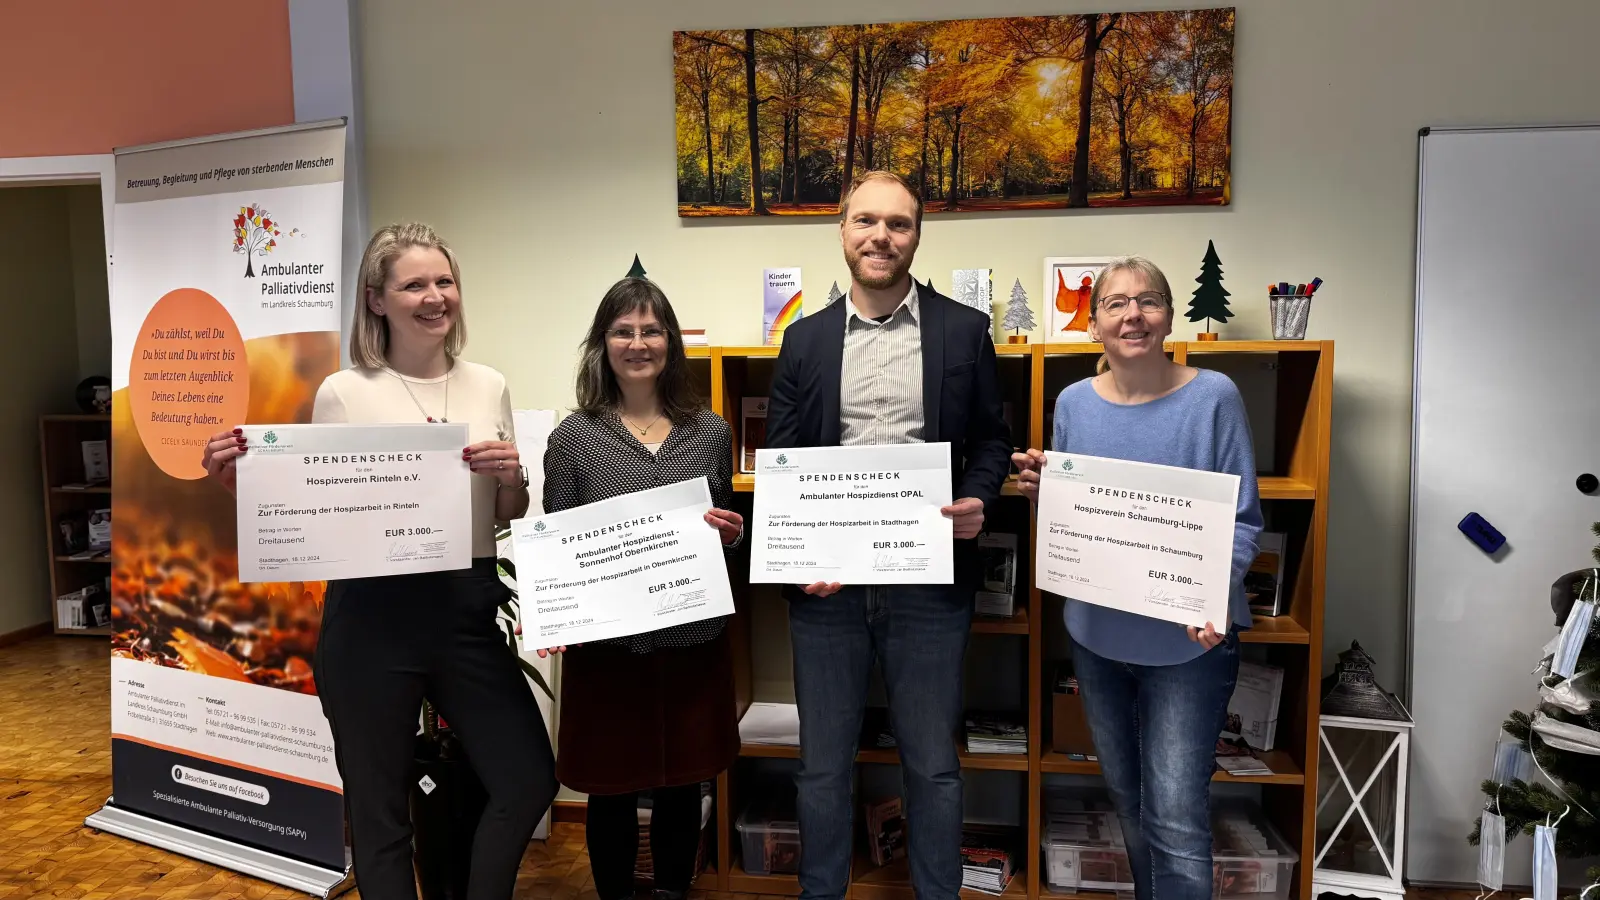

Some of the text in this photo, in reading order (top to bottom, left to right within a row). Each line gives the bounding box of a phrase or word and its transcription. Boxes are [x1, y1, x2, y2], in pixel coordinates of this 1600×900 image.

[127, 157, 334, 189] Betreuung, Begleitung und Pflege von sterbenden Menschen
[261, 262, 324, 276] Ambulanter
[261, 281, 334, 296] Palliativdienst
[261, 299, 334, 309] im Landkreis Schaumburg
[151, 328, 224, 340] »Du zählst, weil Du
[143, 349, 235, 361] Du bist und Du wirst bis
[144, 370, 234, 384] zum letzten Augenblick
[152, 391, 224, 403] Deines Lebens eine
[151, 412, 224, 426] Bedeutung haben.«
[161, 437, 180, 446] CICELY
[304, 454, 422, 464] SPENDENSCHECK
[306, 476, 367, 486] Hospizverein
[370, 475, 402, 483] Rinteln
[800, 472, 900, 482] SPENDENSCHECK
[847, 491, 898, 500] Hospizdienst
[1089, 486, 1193, 508] SPENDENSCHECK
[334, 504, 382, 513] Hospizarbeit
[881, 519, 919, 527] Stadthagen
[1074, 504, 1203, 531] Hospizverein Schaumburg-Lippe
[386, 529, 405, 537] EUR
[561, 514, 664, 545] SPENDENSCHECK
[575, 543, 621, 559] Ambulanter
[623, 530, 675, 548] Hospizdienst
[1061, 529, 1092, 541] Förderung
[1107, 537, 1150, 550] Hospizarbeit
[1160, 545, 1203, 561] Schaumburg
[579, 540, 678, 569] Sonnenhof Obernkirchen
[1049, 552, 1080, 564] Dreitausend
[550, 580, 586, 590] Förderung
[601, 566, 642, 581] Hospizarbeit
[652, 554, 697, 568] Obernkirchen
[1149, 570, 1167, 580] EUR
[649, 583, 666, 594] EUR
[538, 603, 578, 613] Dreitausend
[128, 680, 145, 688] Adresse
[206, 697, 226, 706] Kontakt
[173, 711, 188, 720] GmbH
[185, 773, 208, 785] Besuchen
[218, 782, 228, 790] uns
[229, 785, 238, 795] auf
[238, 787, 264, 800] Facebook
[153, 790, 307, 840] Spezialisierte Ambulante Palliativ-Versorgung (SAPV)
